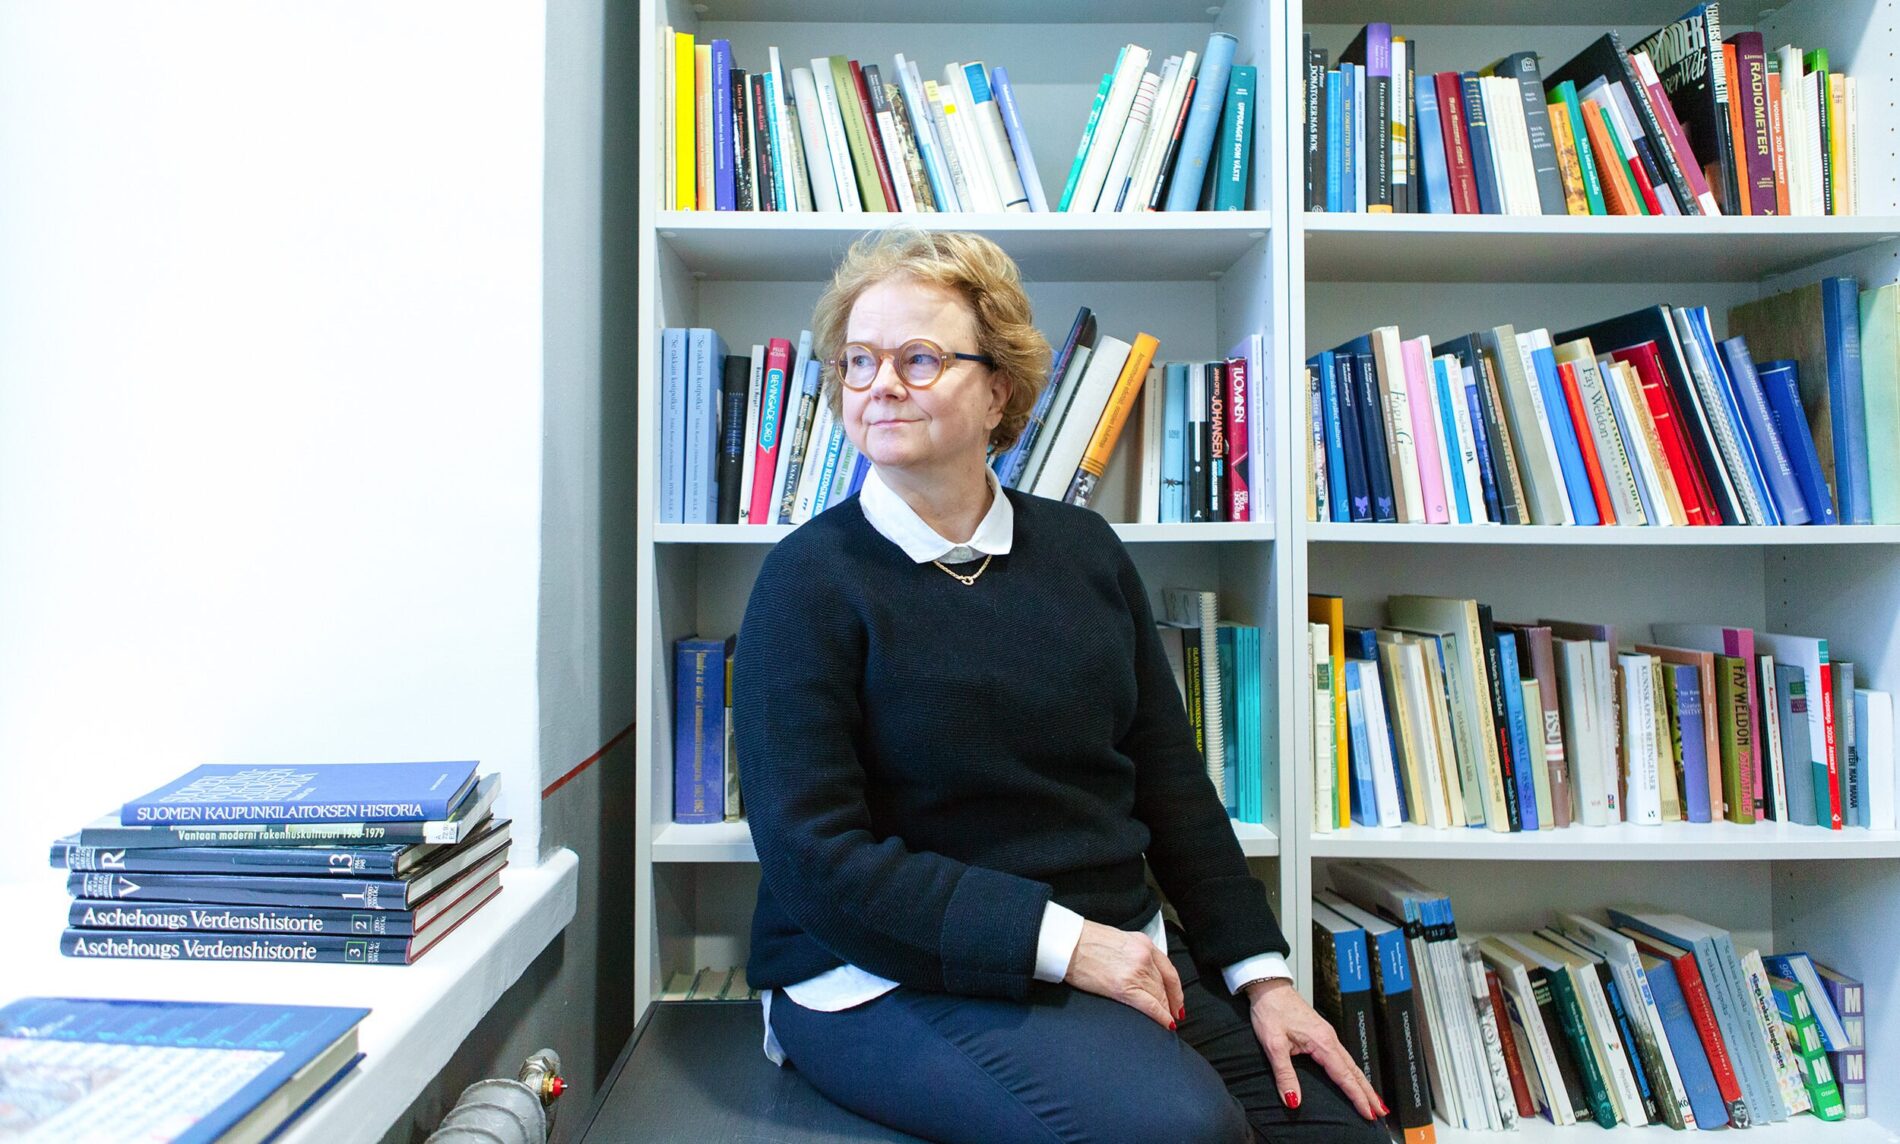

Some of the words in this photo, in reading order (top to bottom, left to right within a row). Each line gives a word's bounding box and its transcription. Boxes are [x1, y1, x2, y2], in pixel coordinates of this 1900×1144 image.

[1705, 2, 1721, 25] WELT
[1707, 24, 1723, 52] DIESER
[1710, 51, 1726, 85] WUNDER
[1309, 64, 1317, 132] DONATORERNAS
[1714, 84, 1728, 103] ALLE
[1234, 101, 1245, 142] UPPDRAGET
[1750, 61, 1768, 155] RADIOMETER
[1233, 143, 1241, 159] SOM
[1772, 99, 1780, 133] VUOSIKIRJA
[1777, 153, 1786, 184] ÅRSSKRIFT
[1231, 159, 1241, 182] VÄXTE
[670, 349, 678, 376] rakkain
[1578, 366, 1598, 390] Fay
[765, 373, 779, 421] BEVINGADE
[1233, 365, 1244, 422] TUOMINEN
[1211, 395, 1222, 457] JOHANSEN
[1586, 389, 1614, 439] Weldon
[762, 421, 773, 442] ORD
[1333, 421, 1343, 448] kulturen
[826, 452, 836, 468] AND
[1764, 420, 1791, 476] sotainvalidi
[1731, 665, 1746, 689] FAY
[1641, 665, 1651, 729] KUNNSKAPENS
[1822, 691, 1831, 724] VUOSIKIRJA
[1543, 709, 1562, 743] BSU
[1733, 691, 1750, 746] WELDON
[1485, 730, 1495, 765] SUOMESSA
[1513, 710, 1527, 762] HARTWALL
[1825, 725, 1833, 743] 2020
[1645, 731, 1655, 790] BETINGELSER
[1827, 745, 1836, 774] ÅRSSKRIFT
[1847, 745, 1855, 765] MITEN
[1848, 767, 1856, 783] MAA
[1849, 784, 1857, 808] MAKAA
[137, 806, 201, 821] SUOMEN
[205, 804, 357, 820] KAUPUNKILAITOKSEN
[360, 803, 424, 817] HISTORIA
[178, 830, 216, 842] Vantaan
[219, 829, 257, 841] moderni
[102, 850, 125, 869] R
[329, 853, 353, 874] 13
[119, 876, 141, 898] V
[342, 892, 365, 900] 1
[82, 907, 188, 930] Aschehougs
[190, 909, 323, 931] Verdenshistorie
[356, 920, 367, 930] 2
[73, 937, 180, 959] Aschehougs
[183, 939, 317, 960] Verdenshistorie
[349, 947, 361, 957] 3
[1794, 991, 1810, 1020] M
[1845, 988, 1861, 1013] M
[1749, 972, 1763, 997] Många
[1757, 996, 1772, 1022] krokar
[1766, 1025, 1786, 1069] långdansen
[1845, 1021, 1862, 1046] M
[1355, 1010, 1370, 1059] STADSBORNAS
[1803, 1023, 1821, 1052] M
[1400, 1010, 1414, 1059] STADSBORNAS
[1408, 1061, 1422, 1107] HELSINGFORS
[1812, 1056, 1832, 1084] M
[1847, 1055, 1864, 1080] M
